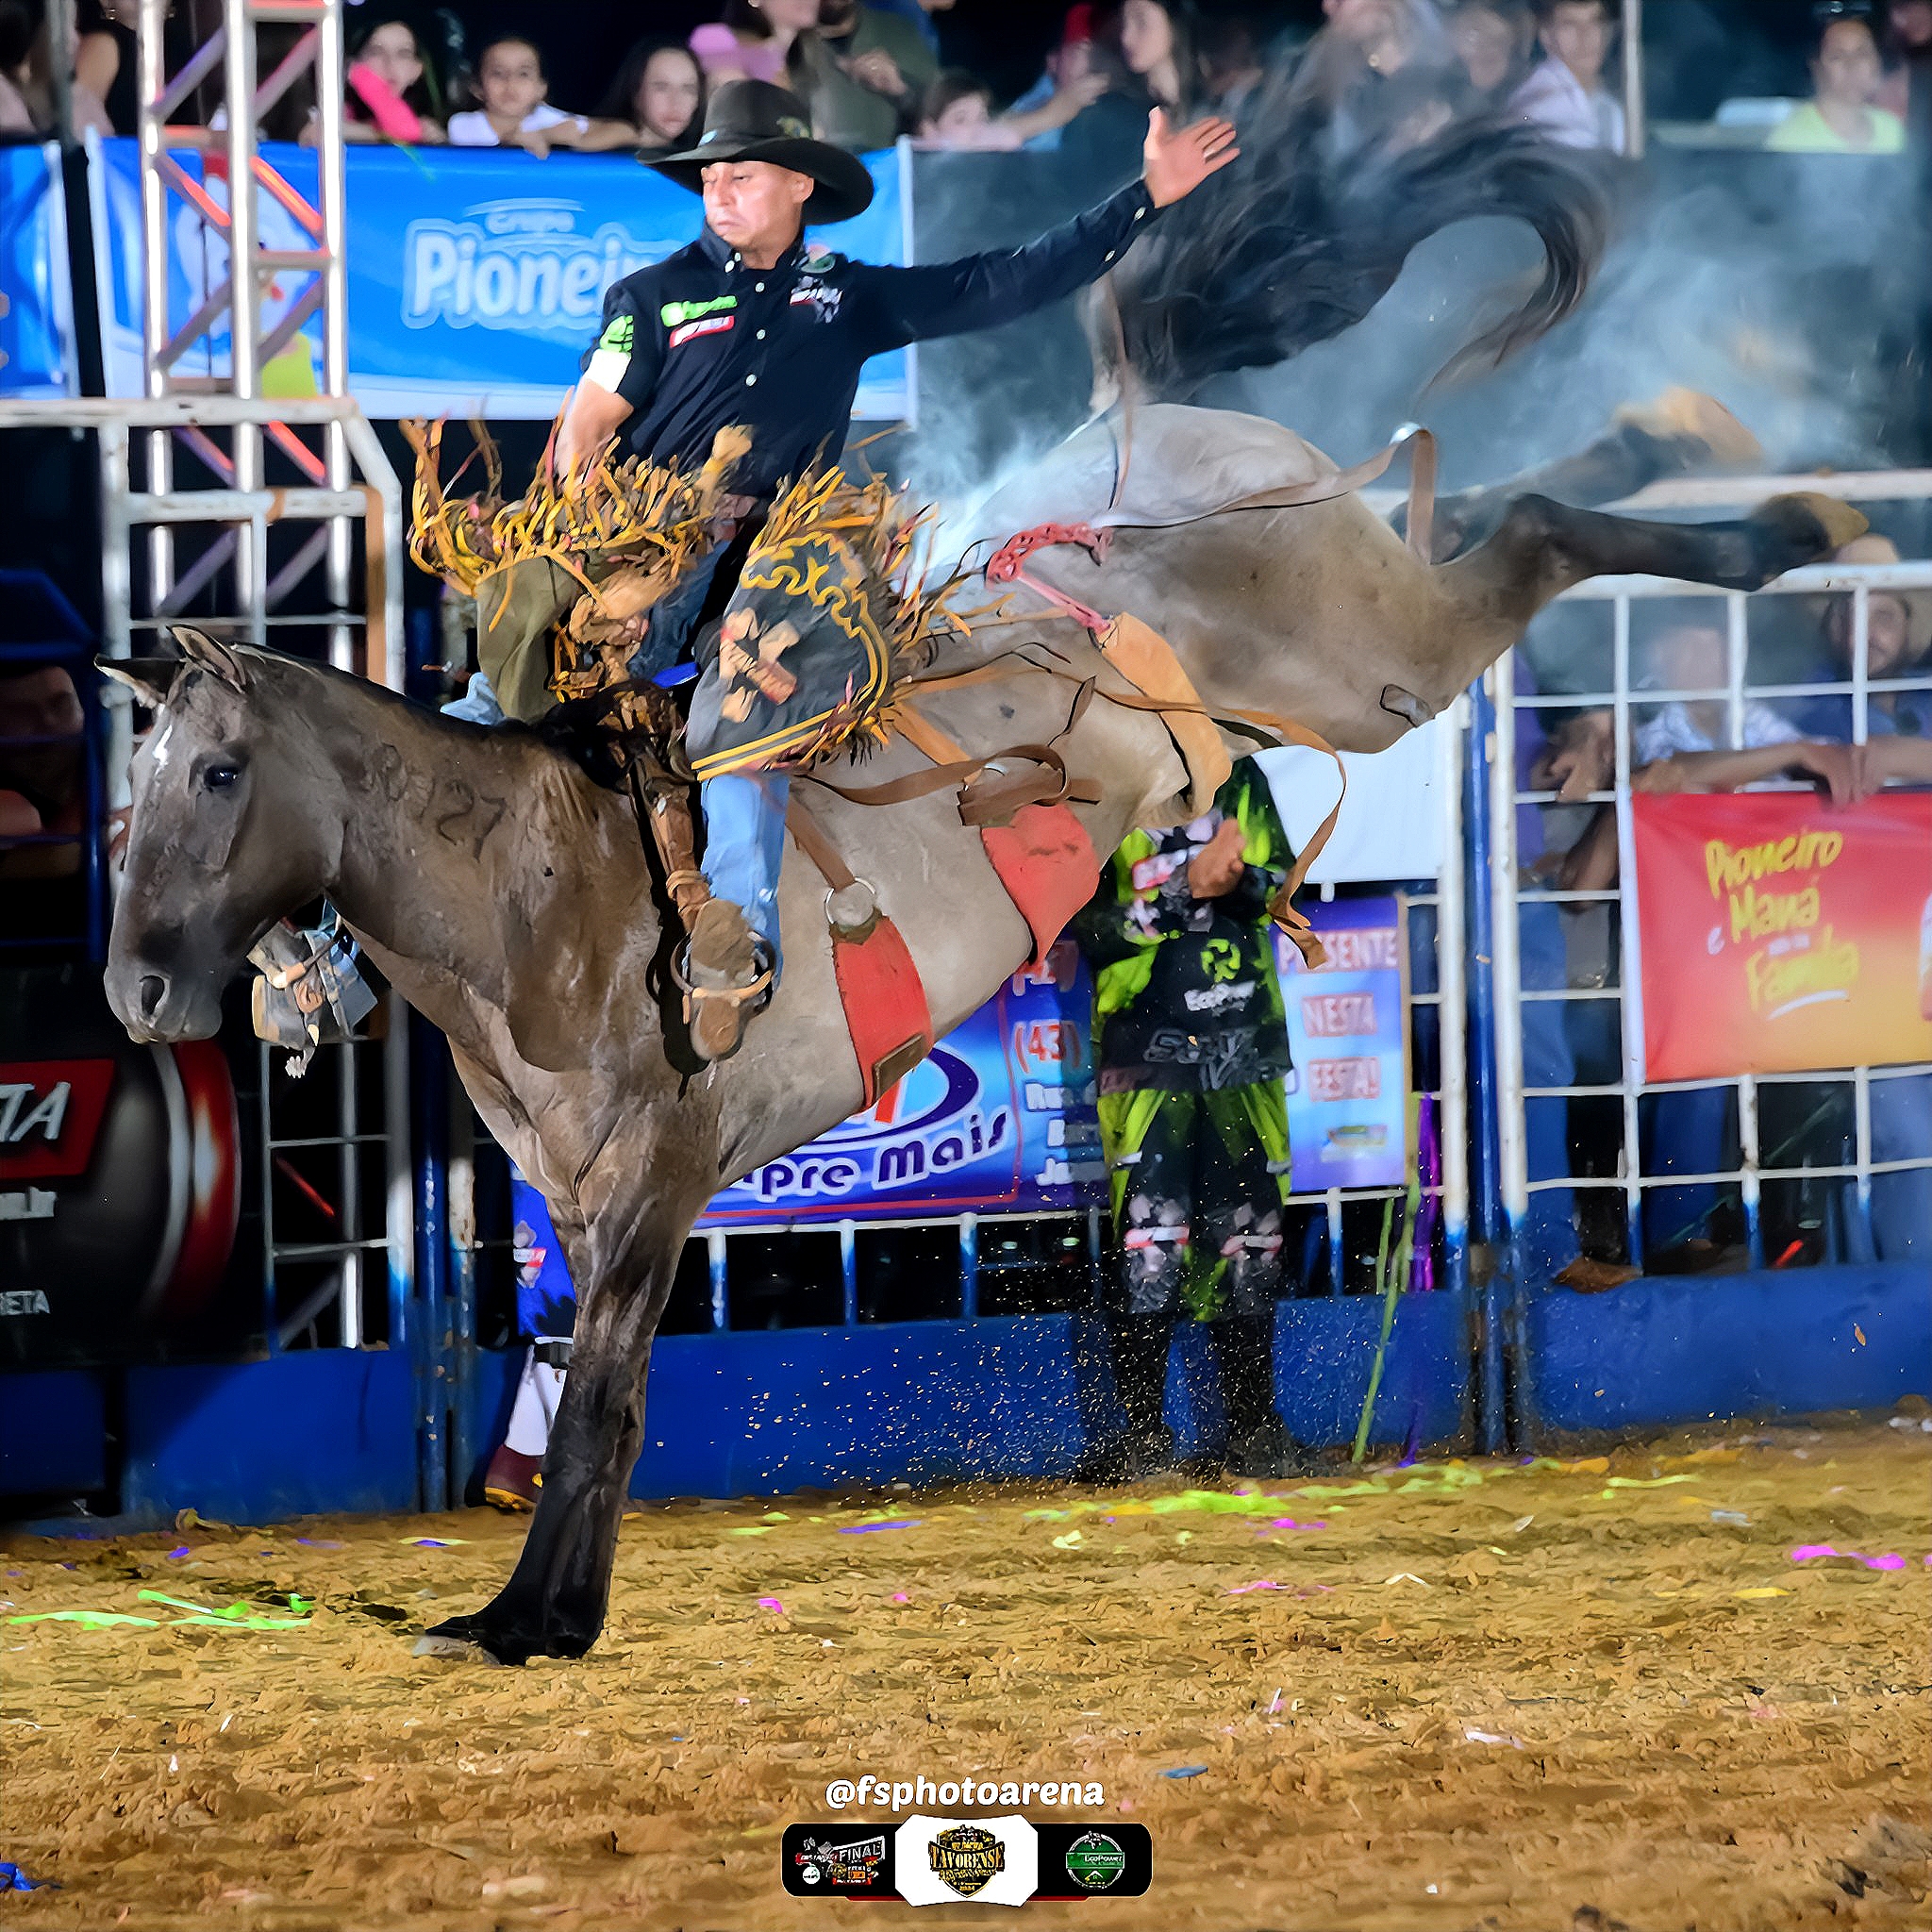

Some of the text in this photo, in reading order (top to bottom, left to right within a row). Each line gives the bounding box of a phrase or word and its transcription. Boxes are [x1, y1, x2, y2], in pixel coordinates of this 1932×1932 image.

[1278, 929, 1398, 974] PSENTE
[1014, 1021, 1081, 1074] (43)
[878, 1112, 1008, 1183] Mais
